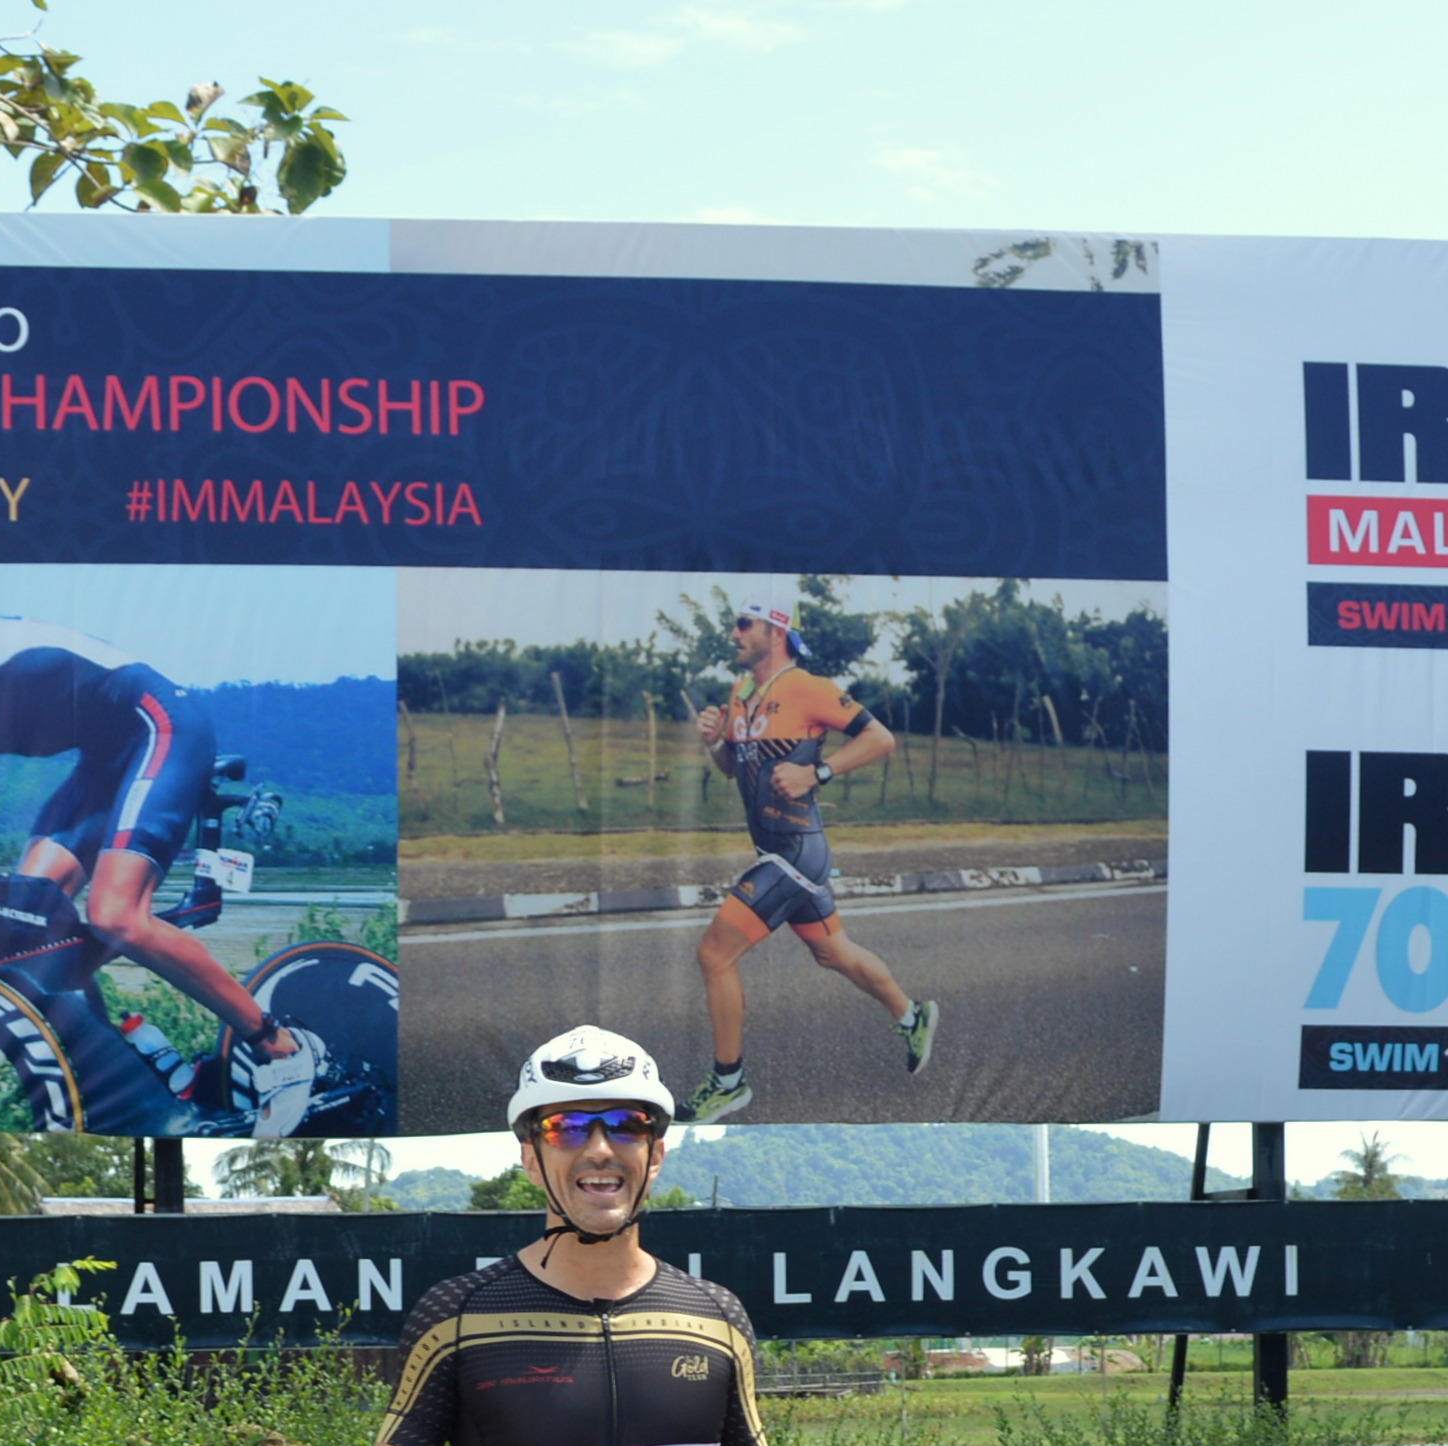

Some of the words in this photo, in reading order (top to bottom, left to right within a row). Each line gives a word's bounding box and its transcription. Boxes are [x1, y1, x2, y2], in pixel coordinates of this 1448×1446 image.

[125, 478, 483, 526] #IMMALAYSIA
[1337, 601, 1445, 631] SWIM
[1329, 1042, 1439, 1072] SWIM
[56, 1258, 404, 1315] LAMAN
[772, 1243, 1300, 1306] LANGKAWI
[499, 1318, 587, 1330] ISLAND
[671, 1355, 709, 1378] Gold
